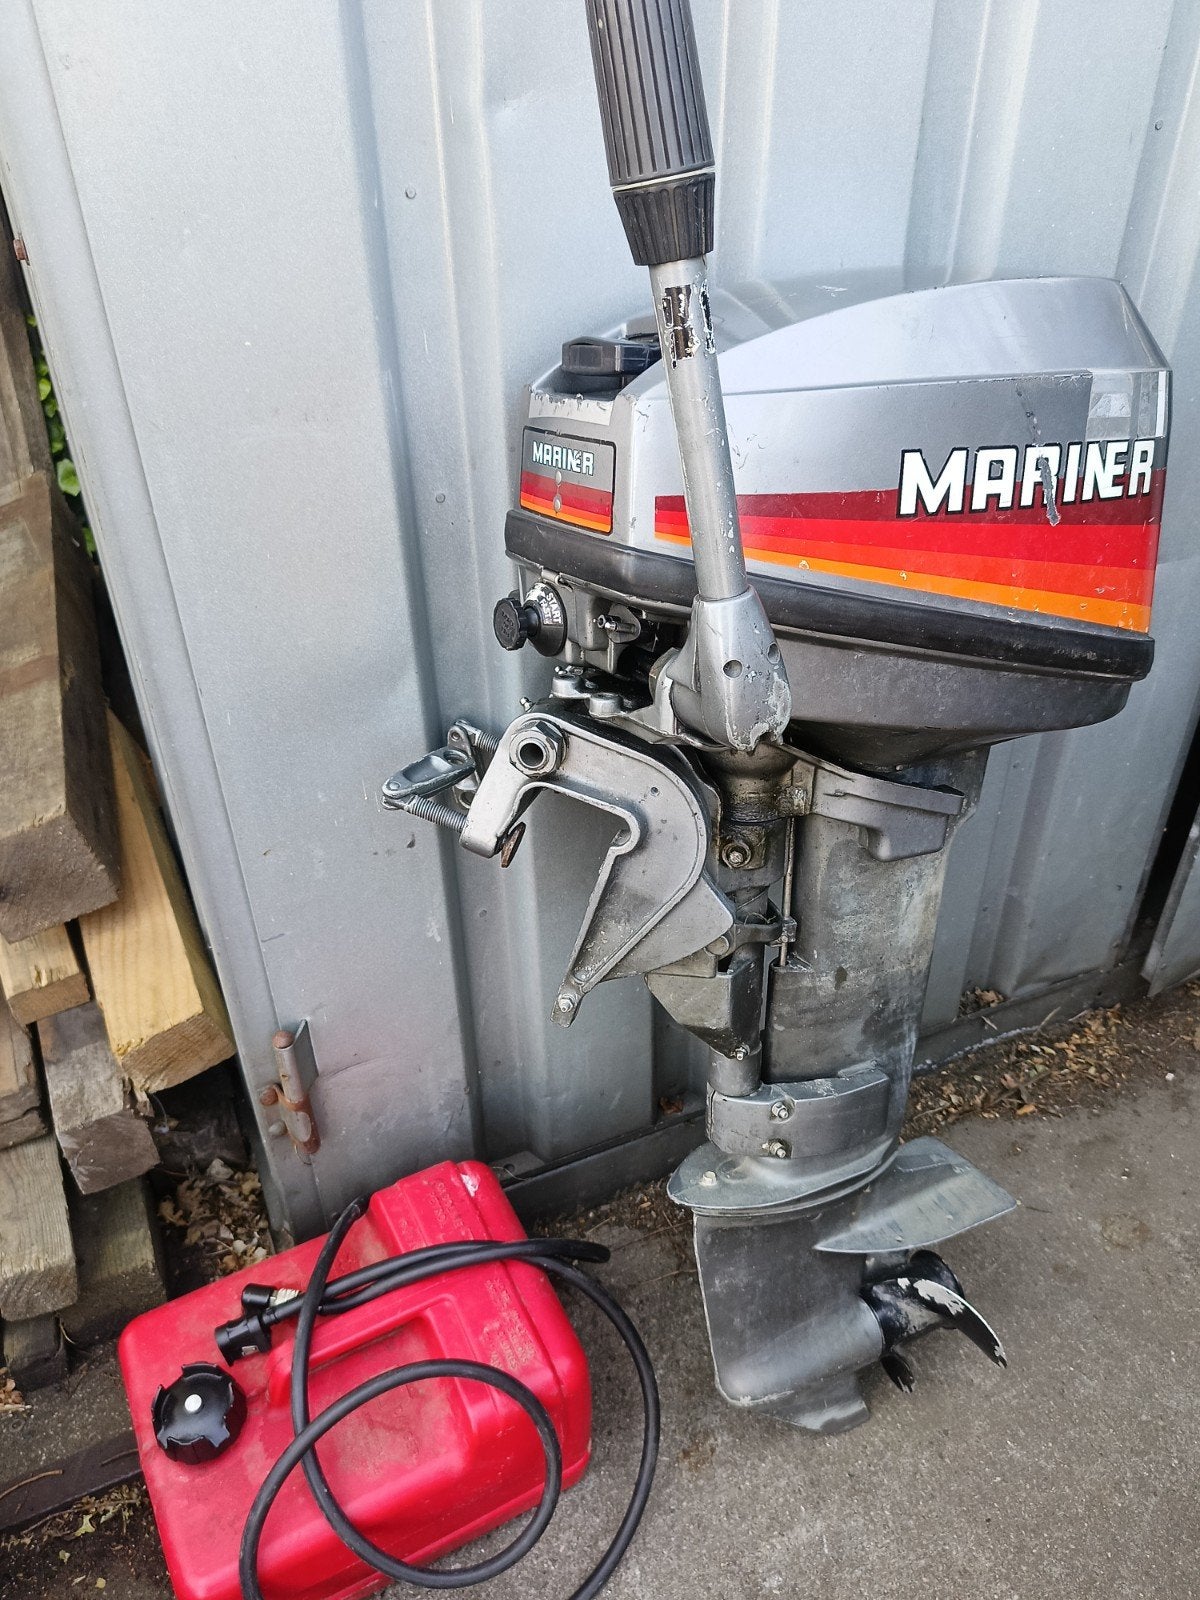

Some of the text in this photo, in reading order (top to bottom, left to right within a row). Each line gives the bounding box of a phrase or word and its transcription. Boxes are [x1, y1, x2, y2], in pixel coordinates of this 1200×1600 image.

[531, 440, 595, 476] MARINER
[897, 438, 1155, 518] MARINER
[546, 592, 562, 624] START
